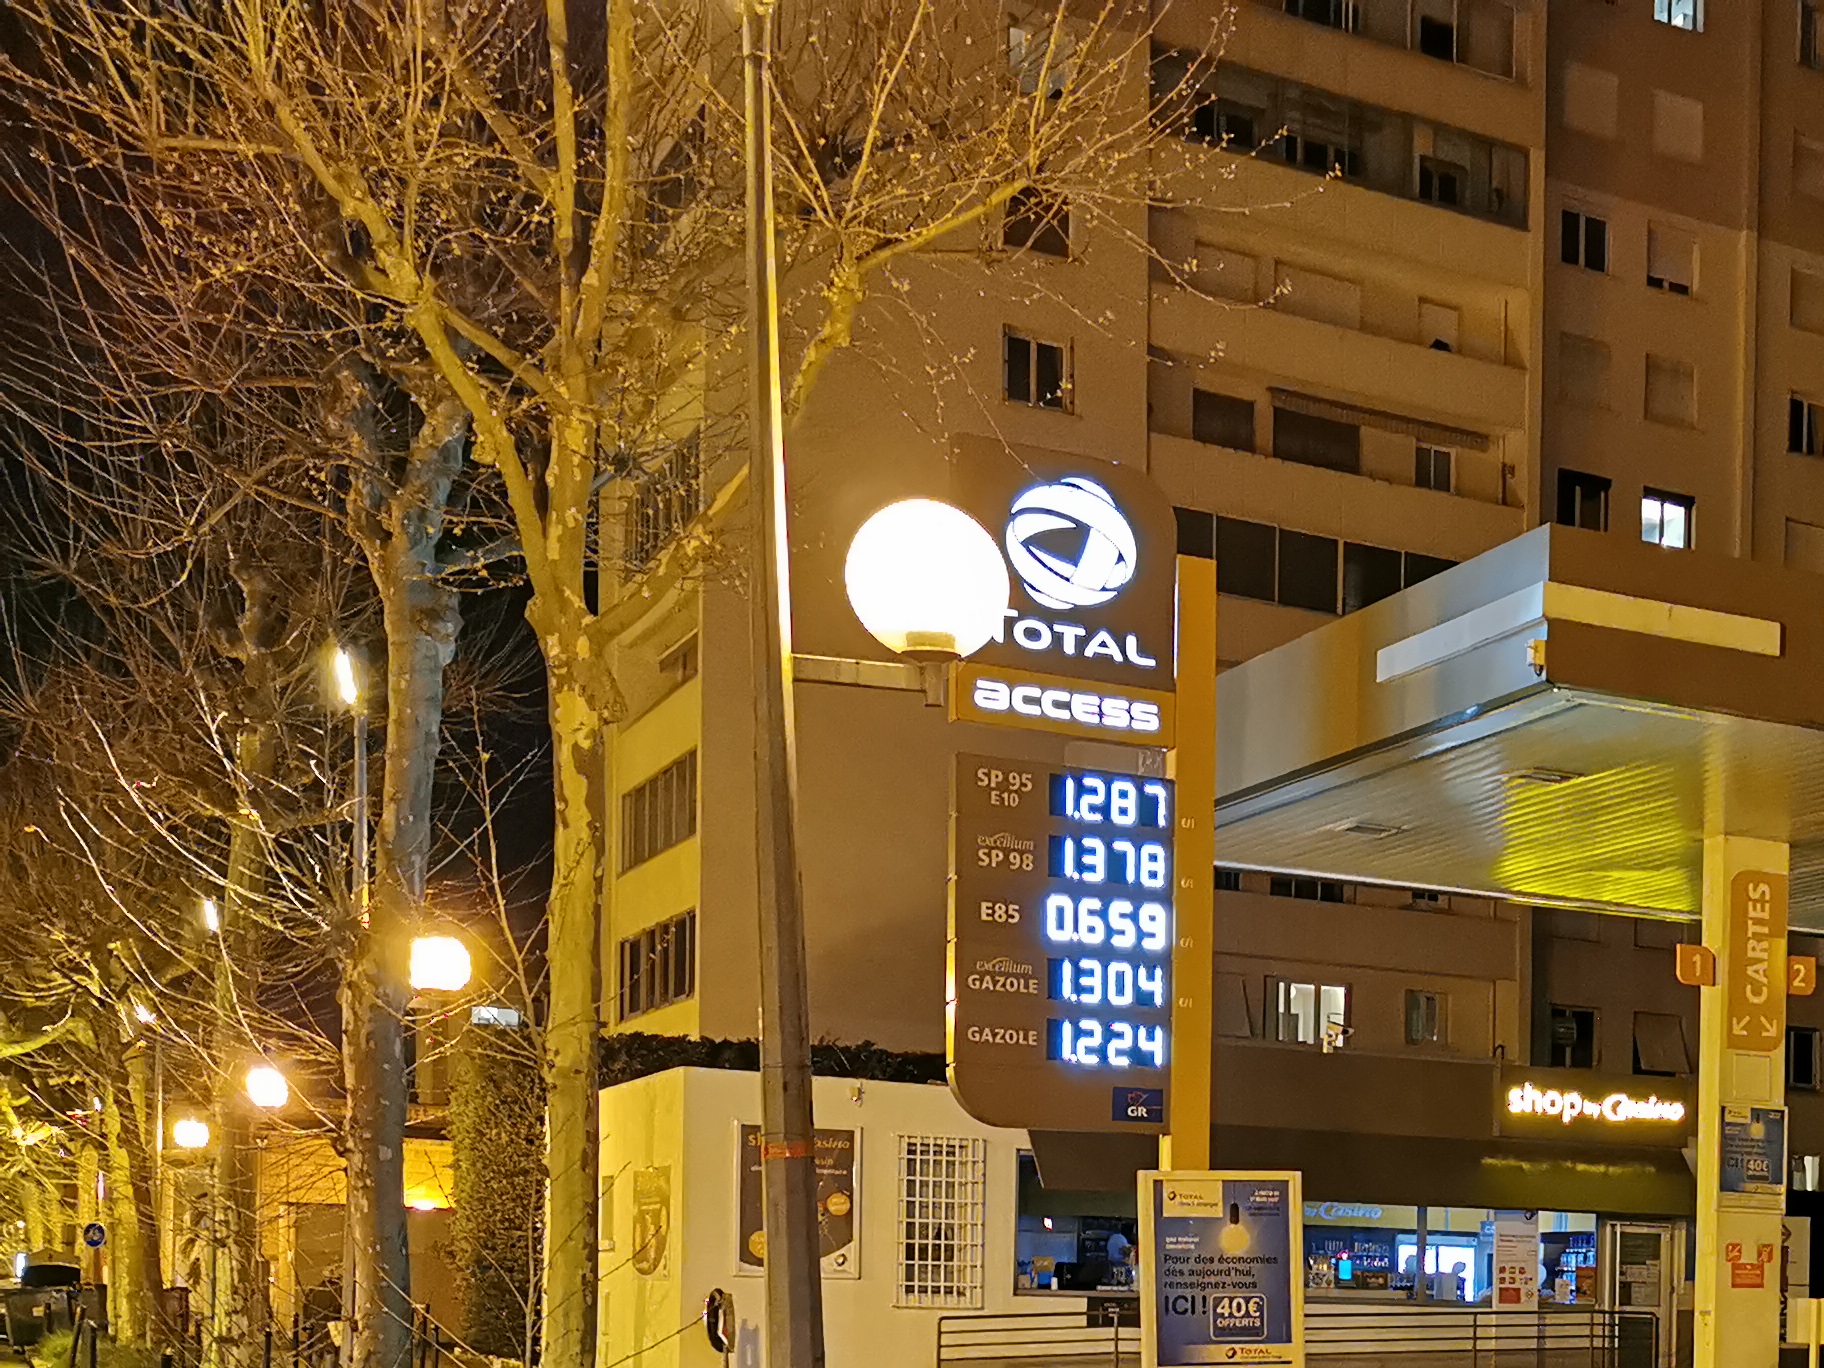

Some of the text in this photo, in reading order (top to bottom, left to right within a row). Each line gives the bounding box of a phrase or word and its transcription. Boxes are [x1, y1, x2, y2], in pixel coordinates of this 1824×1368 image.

[977, 768, 1033, 792] SP 95
[990, 790, 1019, 807] E10
[1062, 775, 1166, 828] 1.287
[978, 849, 1034, 871] SP 98
[1062, 836, 1166, 889] 1.378
[980, 902, 1020, 924] E85
[1046, 893, 1167, 950] 0.659
[1745, 882, 1771, 1005] CARTES
[1692, 953, 1701, 977] 1
[1792, 964, 1806, 987] 2
[967, 974, 1039, 994] GAZOLE
[1061, 958, 1163, 1008] 1.304
[967, 1026, 1038, 1046] GAZOLE
[1061, 1018, 1164, 1069] 1.224
[1127, 1105, 1148, 1118] GR
[1508, 1081, 1583, 1125] shop
[1164, 1254, 1191, 1265] Pour
[1194, 1254, 1215, 1265] des
[1163, 1280, 1258, 1292] renseignez-vous
[1164, 1294, 1196, 1316] ICI
[1216, 1318, 1261, 1328] OFFERTS
[1239, 1347, 1272, 1355] TOTAL
